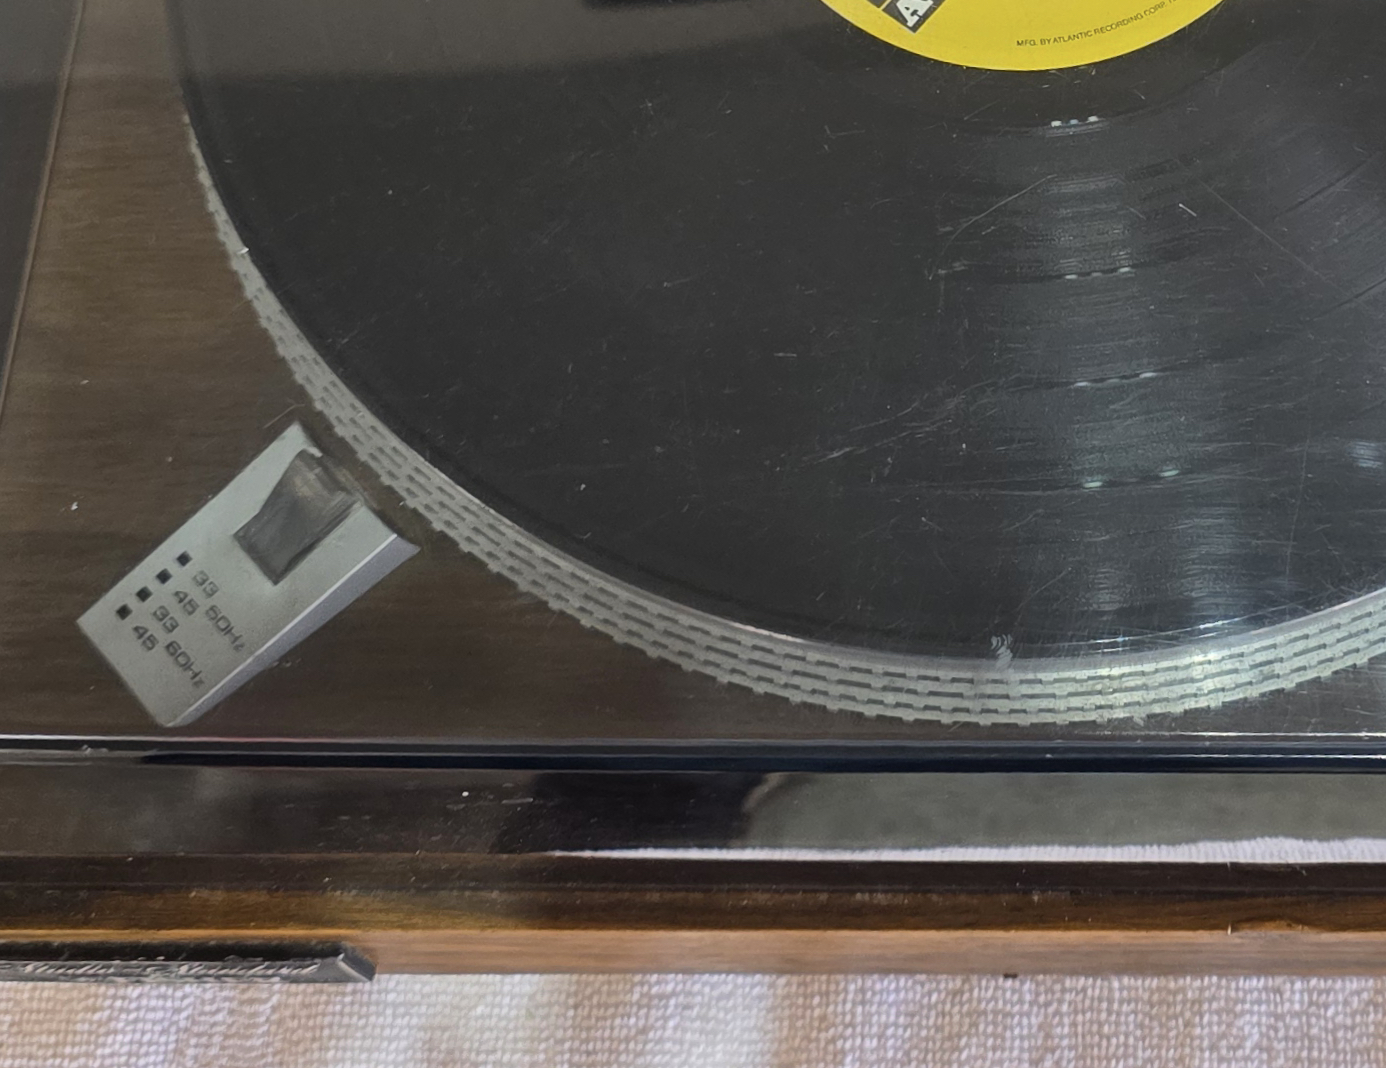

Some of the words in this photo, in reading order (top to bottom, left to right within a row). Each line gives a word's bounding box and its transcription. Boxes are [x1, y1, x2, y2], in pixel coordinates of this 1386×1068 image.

[1040, 38, 1052, 46] BY
[1052, 30, 1093, 44] ATLANTIC
[1093, 12, 1144, 35] RECORDING
[132, 624, 158, 652] 45
